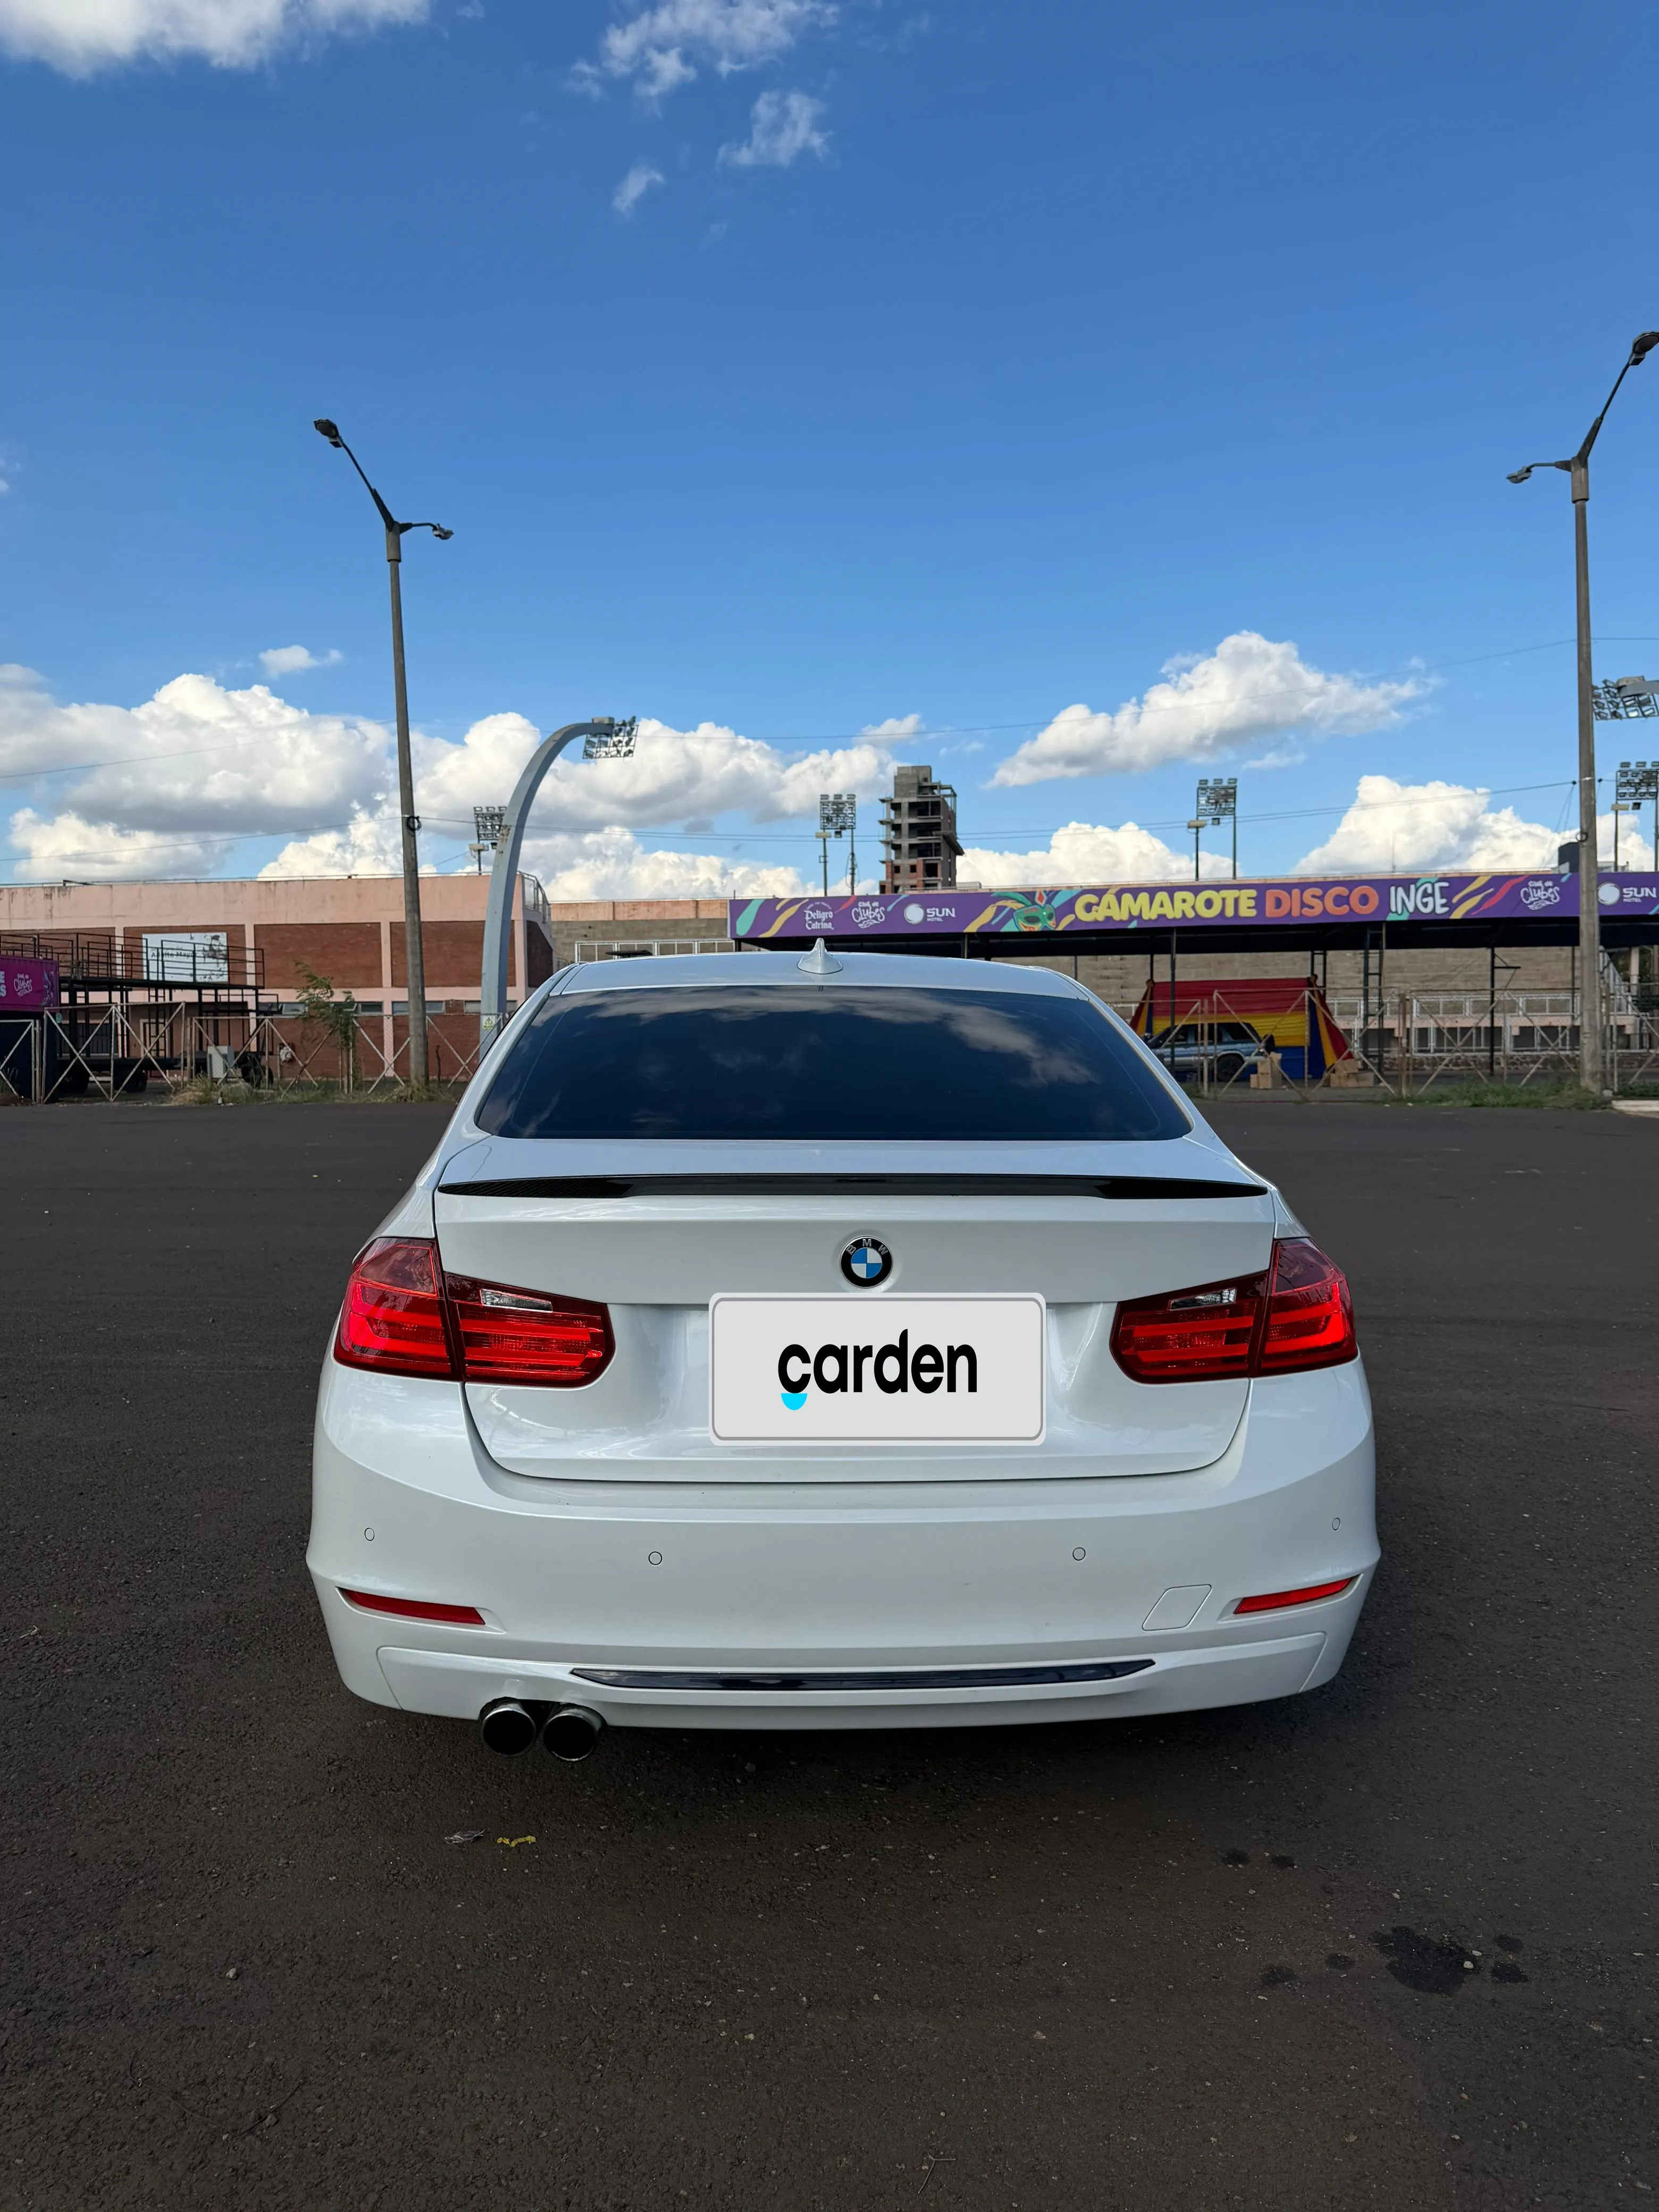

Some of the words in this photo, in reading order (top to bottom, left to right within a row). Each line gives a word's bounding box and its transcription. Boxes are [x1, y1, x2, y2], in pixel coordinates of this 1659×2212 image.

[1520, 884, 1560, 903] Clubes
[1622, 887, 1657, 898] SUN
[1075, 890, 1257, 921] CAMAROTE
[1266, 886, 1379, 917] DISCO
[1389, 881, 1450, 915] INGE
[804, 910, 833, 921] Peligro
[851, 906, 885, 923] Clubes
[926, 907, 956, 917] SUN
[805, 921, 834, 930] Catrina
[846, 1238, 889, 1255] BMW
